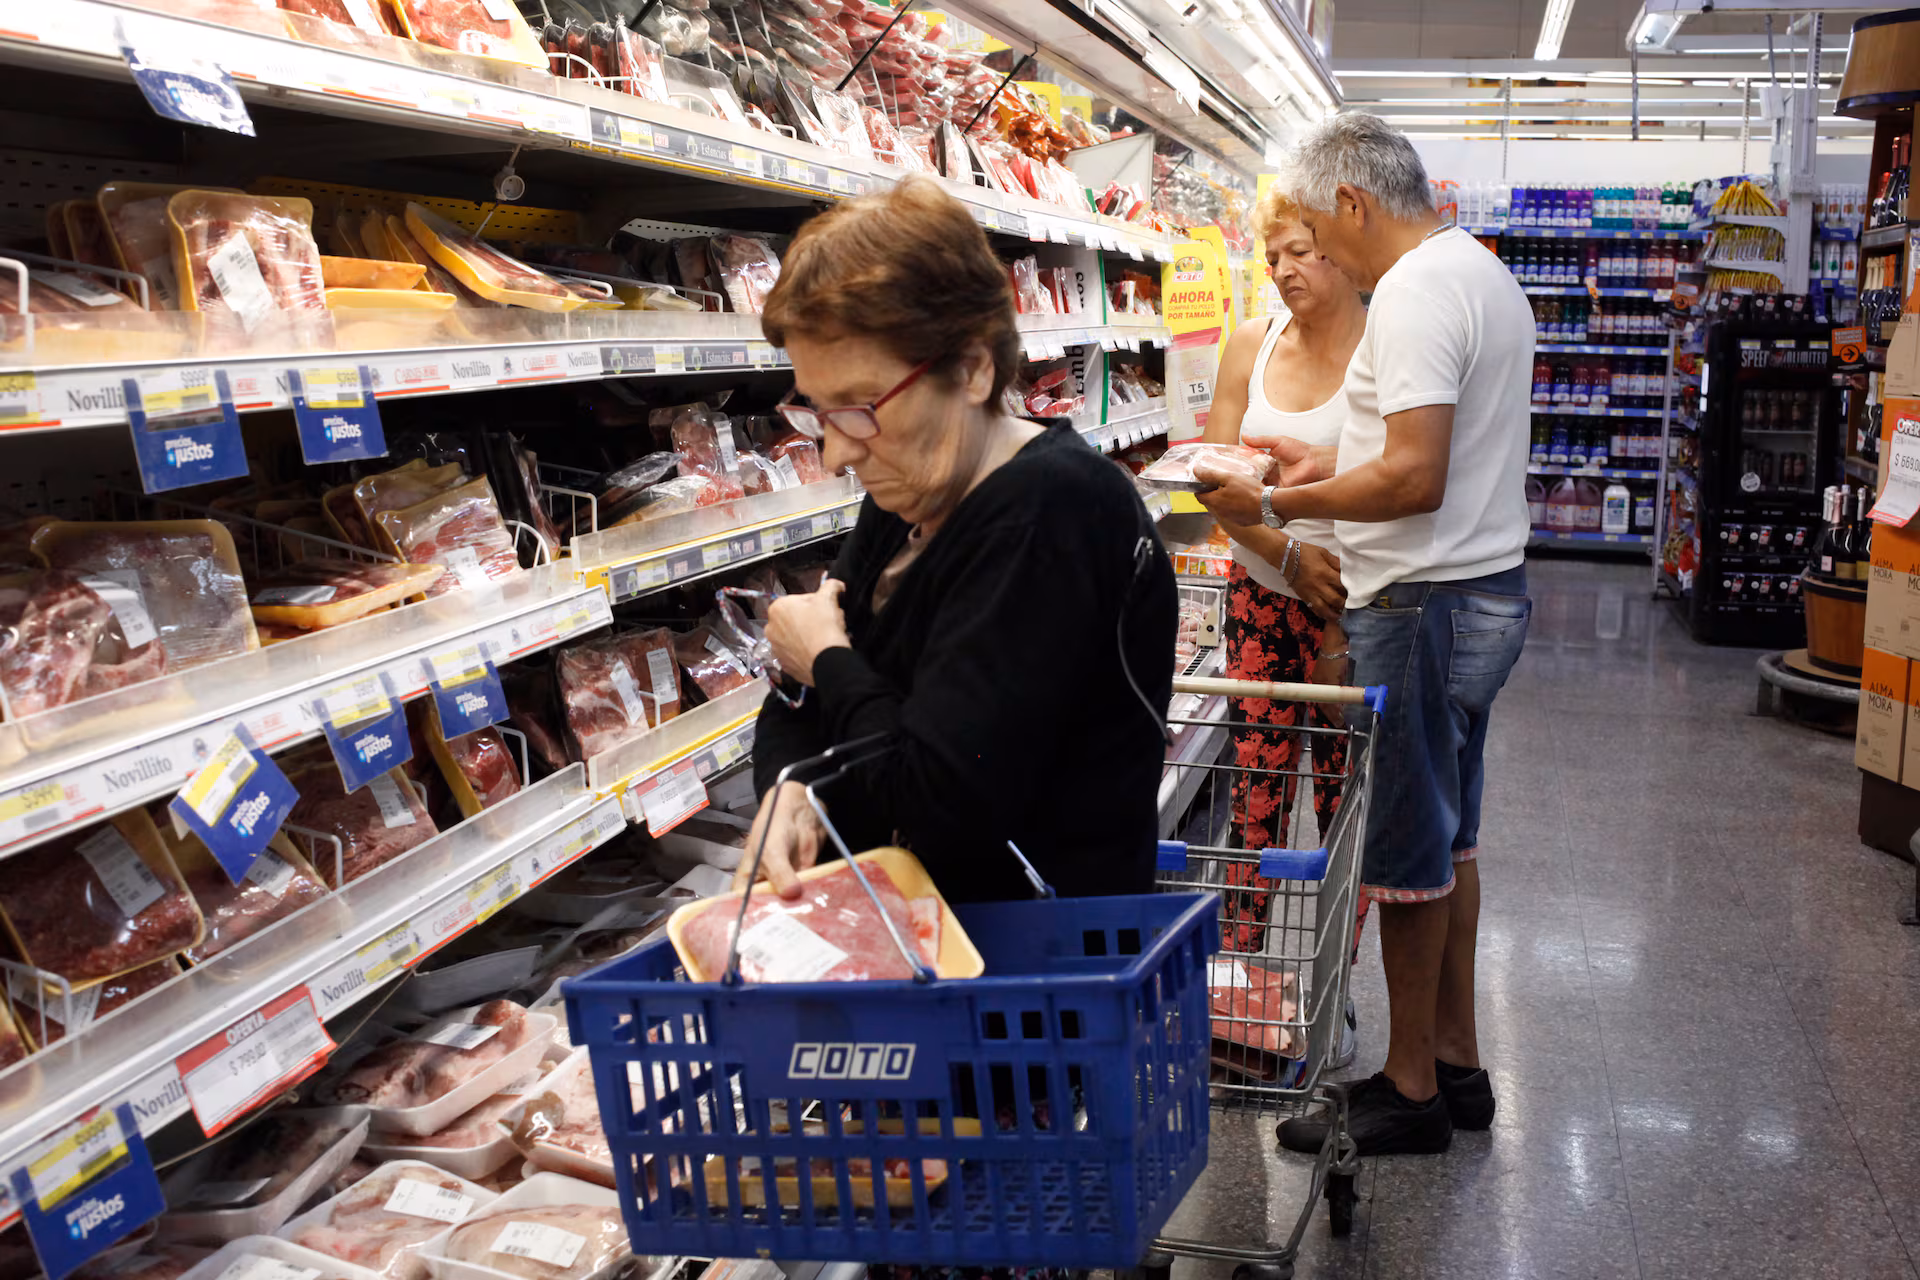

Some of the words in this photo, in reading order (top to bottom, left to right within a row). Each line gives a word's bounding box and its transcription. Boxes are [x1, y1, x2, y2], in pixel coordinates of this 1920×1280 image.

[1169, 291, 1215, 304] AHORA
[1168, 312, 1183, 320] POR
[1185, 310, 1216, 319] TAMAÑO
[451, 360, 491, 379] Novillito
[567, 352, 599, 368] Novillito
[1189, 382, 1205, 394] T5
[331, 423, 362, 443] justos
[175, 441, 214, 468] justos
[1873, 567, 1893, 580] MORA
[1874, 558, 1894, 570] ALMA
[1869, 682, 1894, 700] ALMA
[464, 694, 489, 717] justos
[1868, 693, 1893, 713] MORA
[363, 734, 393, 763] justos
[102, 756, 173, 793] Novillito
[242, 791, 271, 836] justos
[225, 1010, 267, 1046] OFERTA
[787, 1043, 917, 1080] COTO
[78, 1193, 125, 1240] justos
